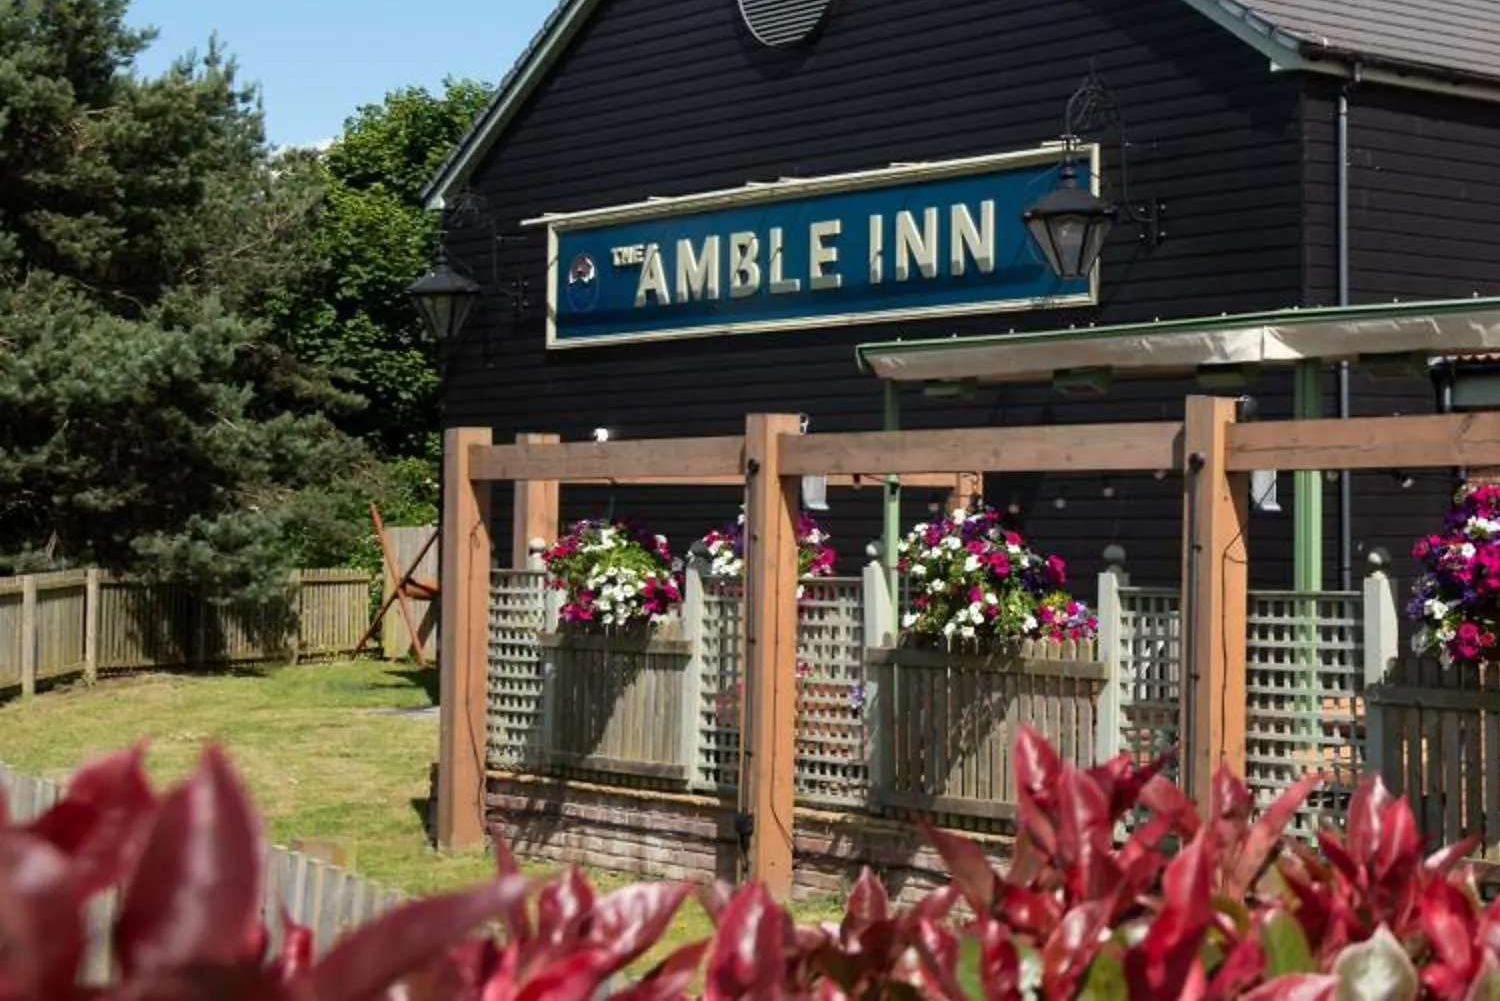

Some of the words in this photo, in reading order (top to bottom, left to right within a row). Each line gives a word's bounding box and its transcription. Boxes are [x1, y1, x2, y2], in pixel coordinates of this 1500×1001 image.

[610, 244, 646, 266] THE
[633, 218, 842, 308] AMBLE
[868, 199, 995, 285] INN
